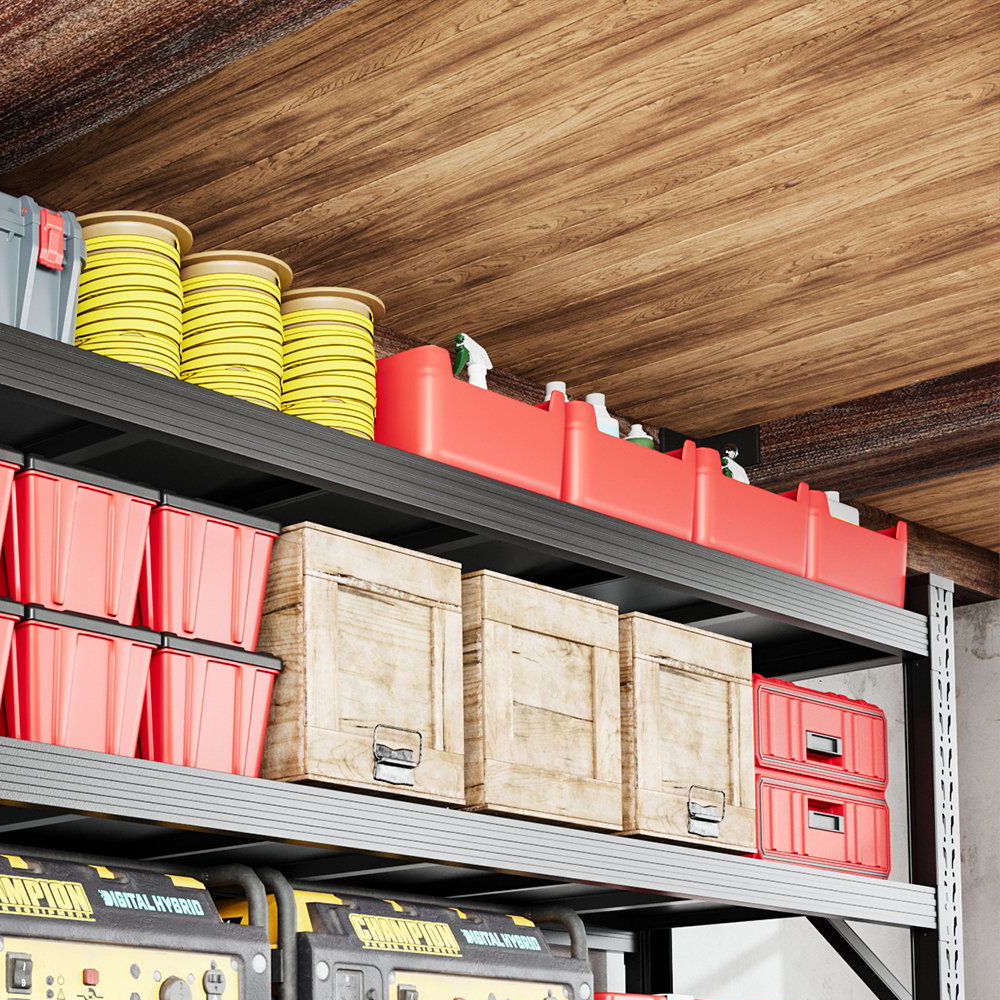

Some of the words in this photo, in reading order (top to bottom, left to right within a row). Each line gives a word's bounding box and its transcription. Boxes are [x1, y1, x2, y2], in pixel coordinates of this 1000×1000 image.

[98, 889, 156, 911] DIGITAL
[152, 895, 205, 916] HYBRID
[350, 914, 460, 950] CHAMPION
[460, 928, 506, 948] DIGITAL
[500, 933, 541, 951] HYBRID
